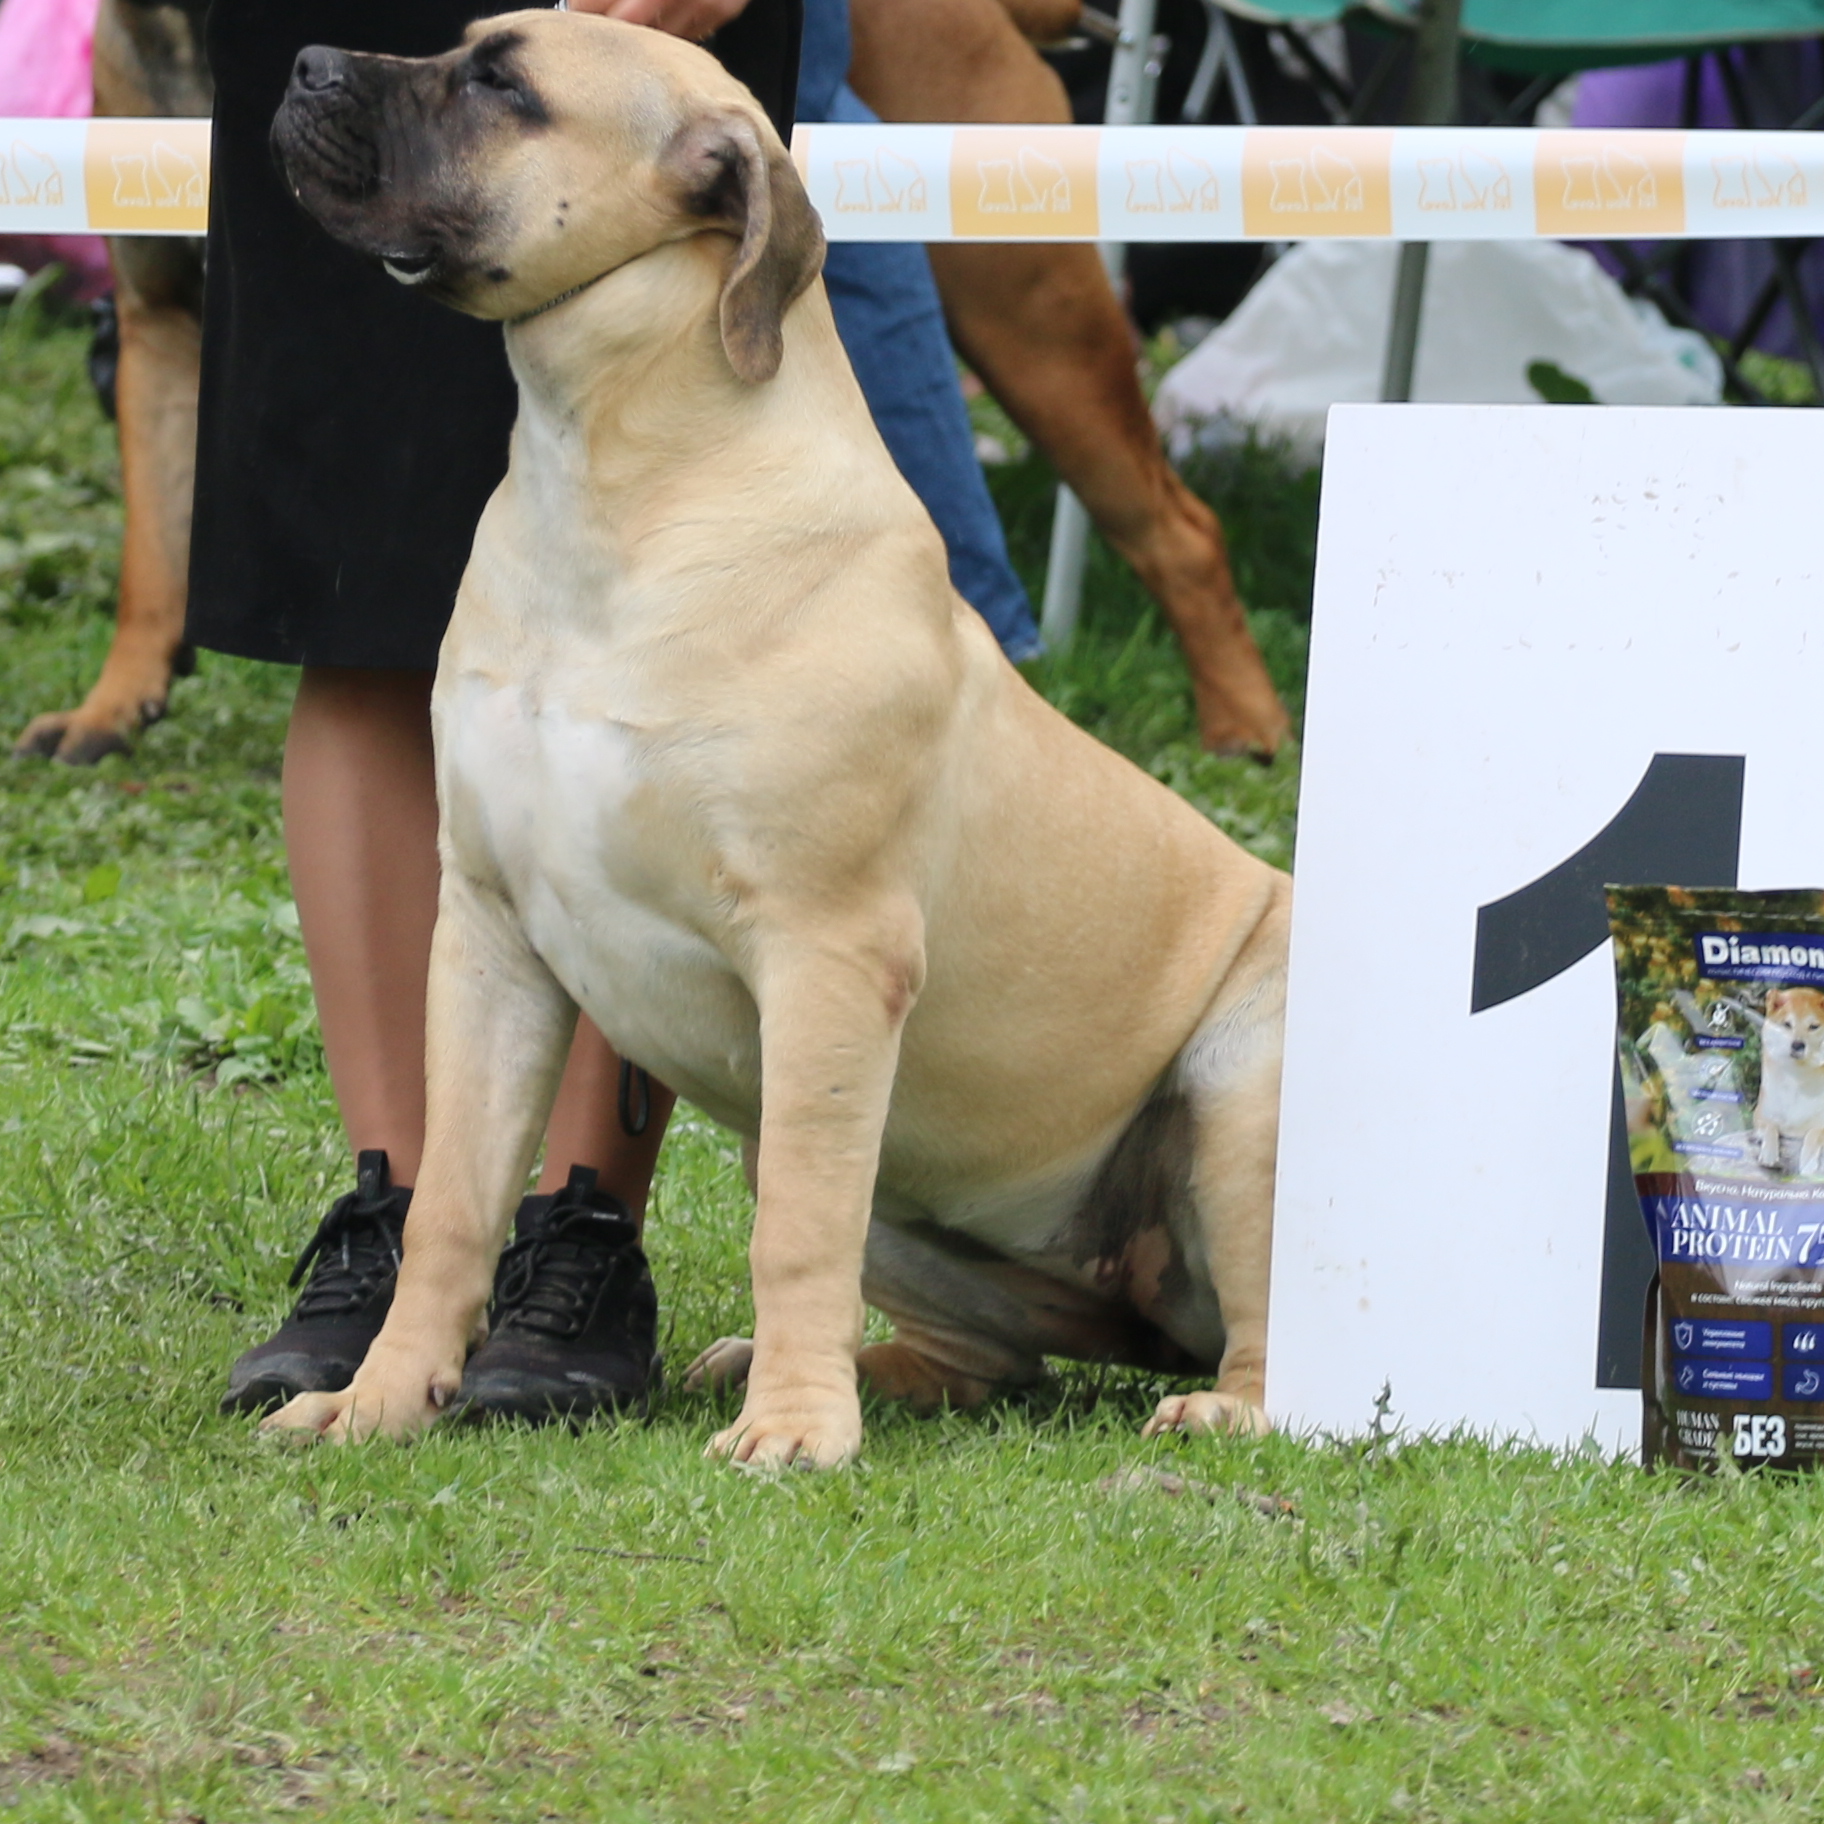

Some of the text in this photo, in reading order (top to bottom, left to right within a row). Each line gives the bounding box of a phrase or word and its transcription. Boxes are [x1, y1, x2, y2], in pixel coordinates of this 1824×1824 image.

[1471, 752, 1745, 1389] 1
[1695, 1179, 1738, 1195] Вкусно.
[1671, 1202, 1784, 1236] ANIMAL
[1672, 1229, 1796, 1261] PROTEIN
[1770, 1280, 1823, 1294] Ingredients
[1733, 1413, 1787, 1457] БЕЗ
